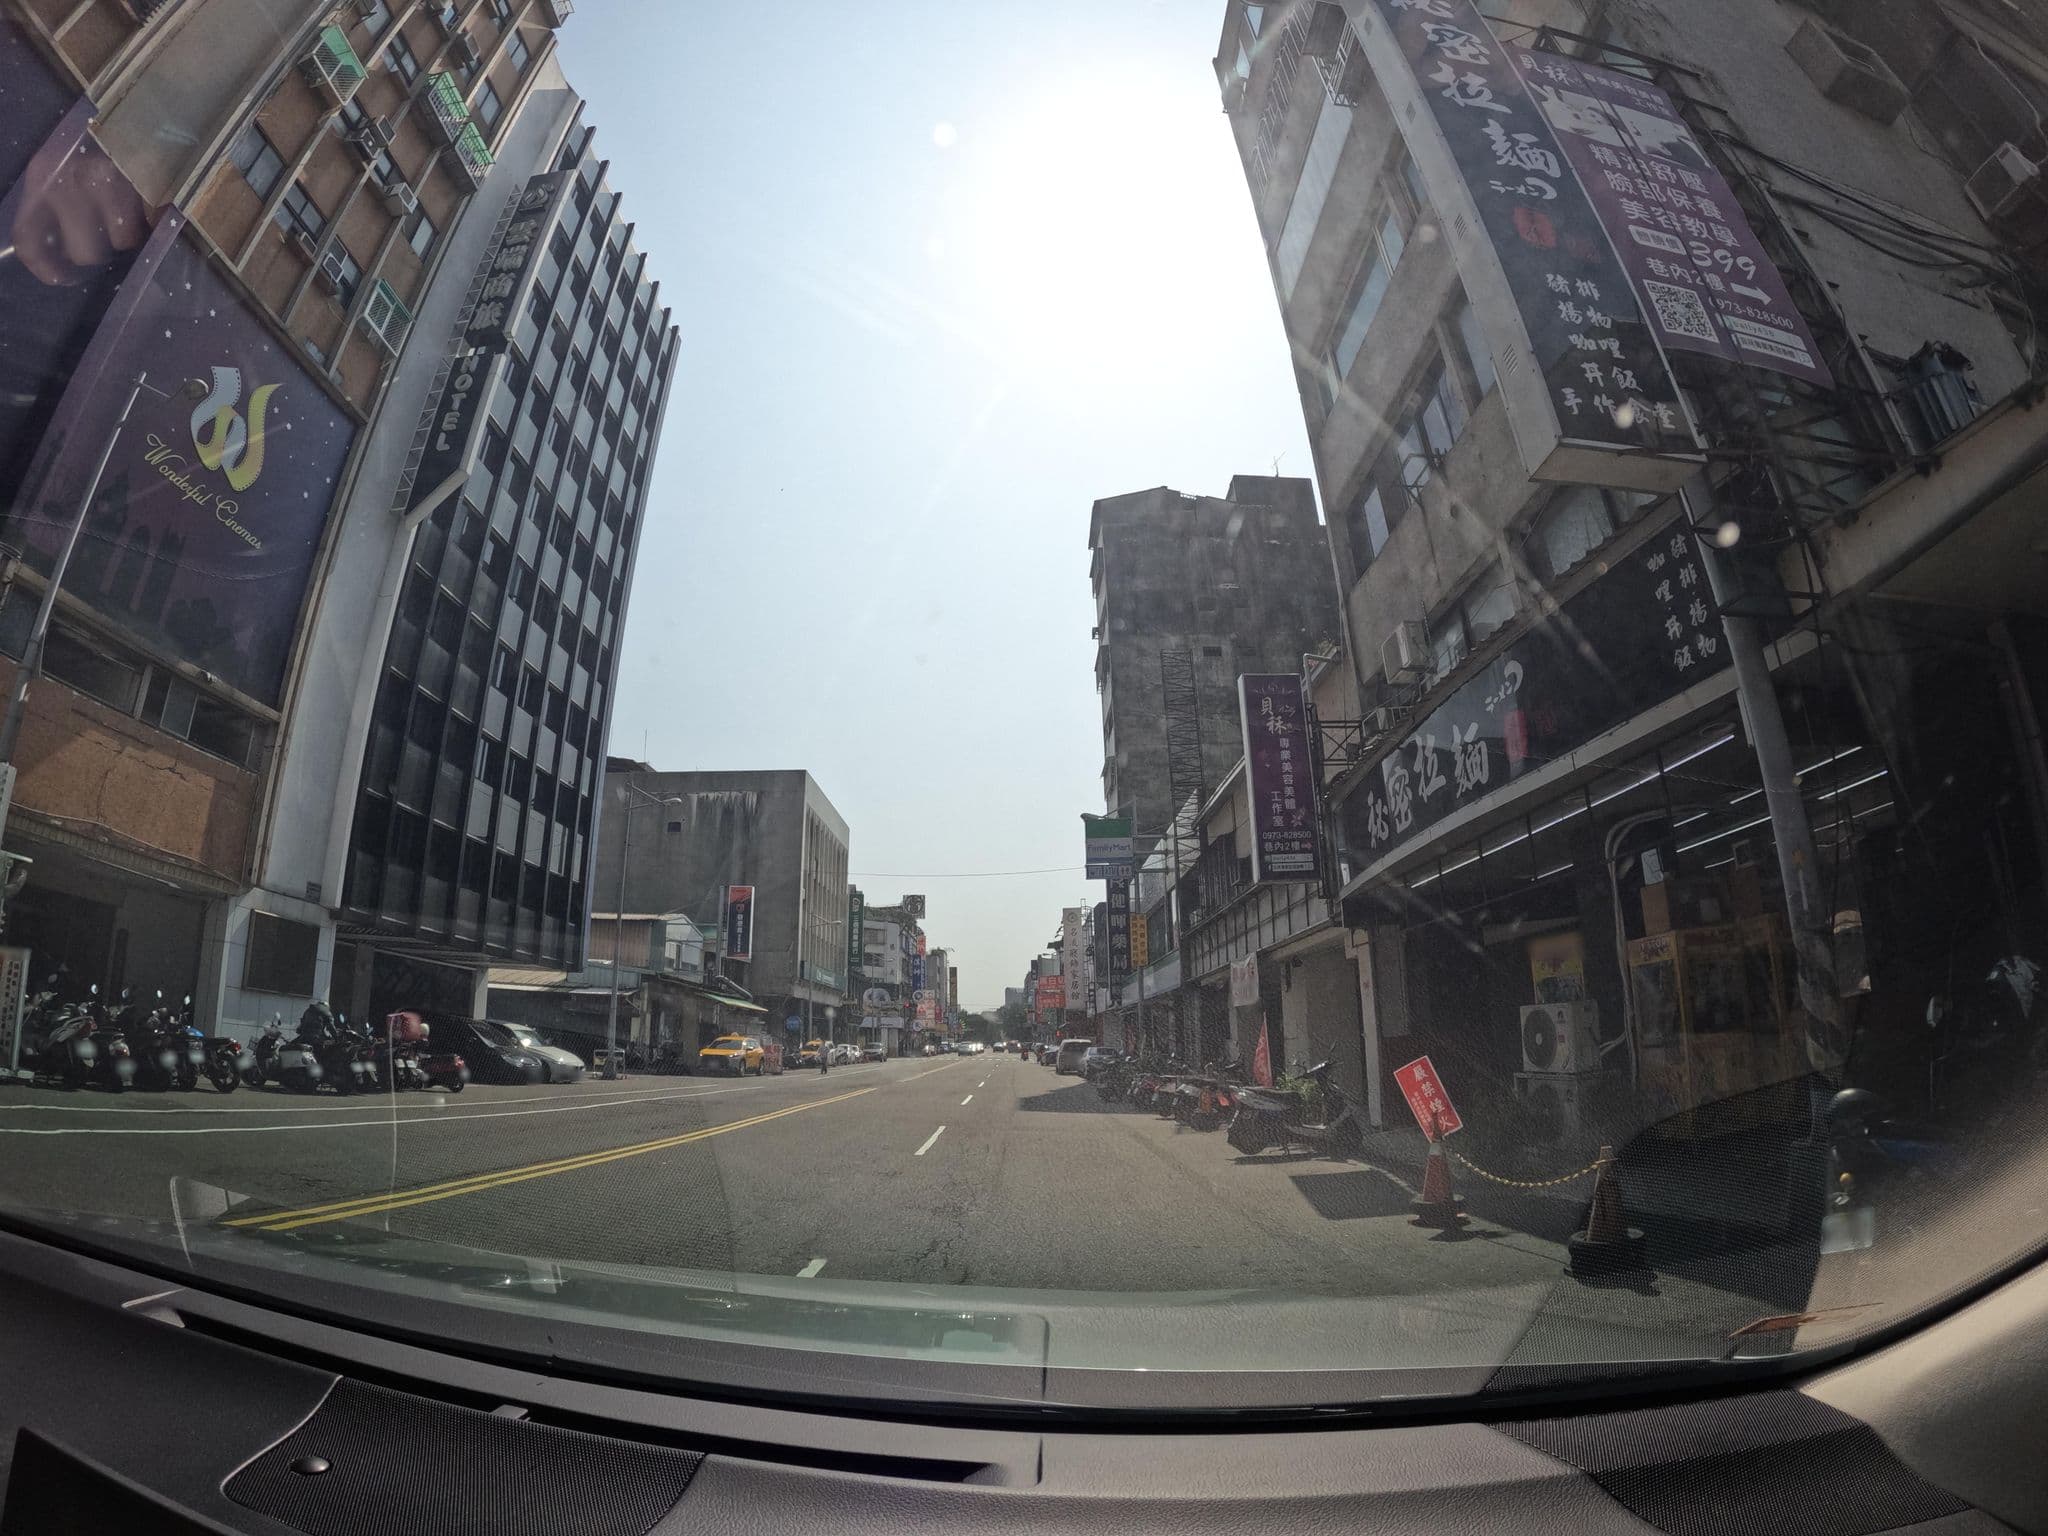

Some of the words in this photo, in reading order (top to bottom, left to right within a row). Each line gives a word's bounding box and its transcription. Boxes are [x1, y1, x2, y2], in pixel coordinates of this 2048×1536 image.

[1588, 143, 1709, 194] 精油舒壓
[1603, 169, 1726, 222] 臉部保養
[1620, 197, 1741, 247] 美容教學
[1688, 240, 1757, 281] 399
[1568, 333, 1626, 360] 咖哩
[436, 353, 479, 451] HOTEL
[1561, 387, 1676, 430] 手作食堂
[144, 433, 213, 506] Wonderful
[215, 495, 263, 550] Cinemas
[1271, 790, 1285, 827] 工作室
[1367, 722, 1490, 849] 秘密拉麵
